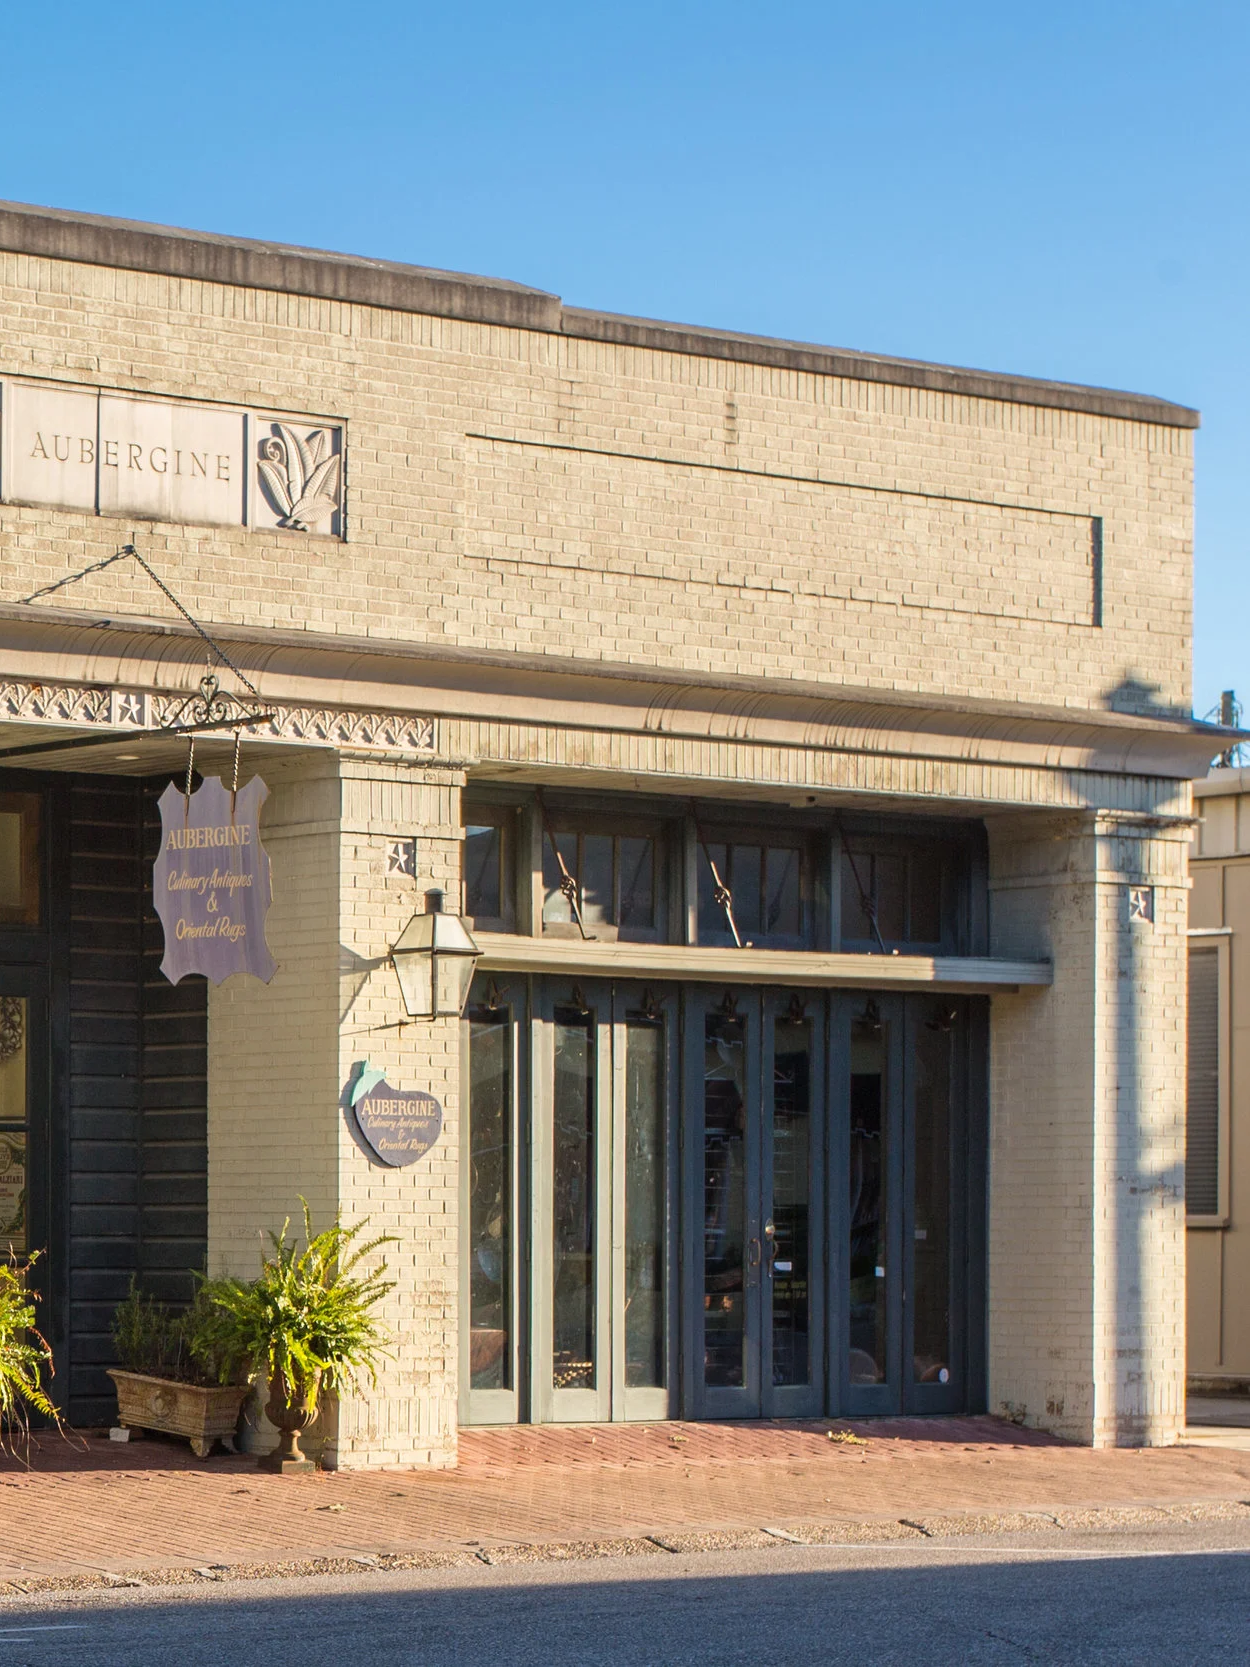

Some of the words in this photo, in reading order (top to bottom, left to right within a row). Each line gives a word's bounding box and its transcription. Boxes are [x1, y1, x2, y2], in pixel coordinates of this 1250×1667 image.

[30, 431, 231, 482] AUBERGINE
[166, 824, 251, 850] AUBERGINE
[167, 868, 210, 896] Culinary
[209, 868, 253, 898] Antiques
[206, 891, 219, 913] &
[175, 917, 221, 940] Oriental
[219, 915, 246, 943] Rugs
[361, 1099, 436, 1117] AUBERGINE
[367, 1116, 395, 1131] Culinary
[396, 1117, 429, 1132] Antiques
[398, 1129, 406, 1140] &
[378, 1137, 409, 1151] Oriental
[409, 1139, 428, 1154] Rugs
